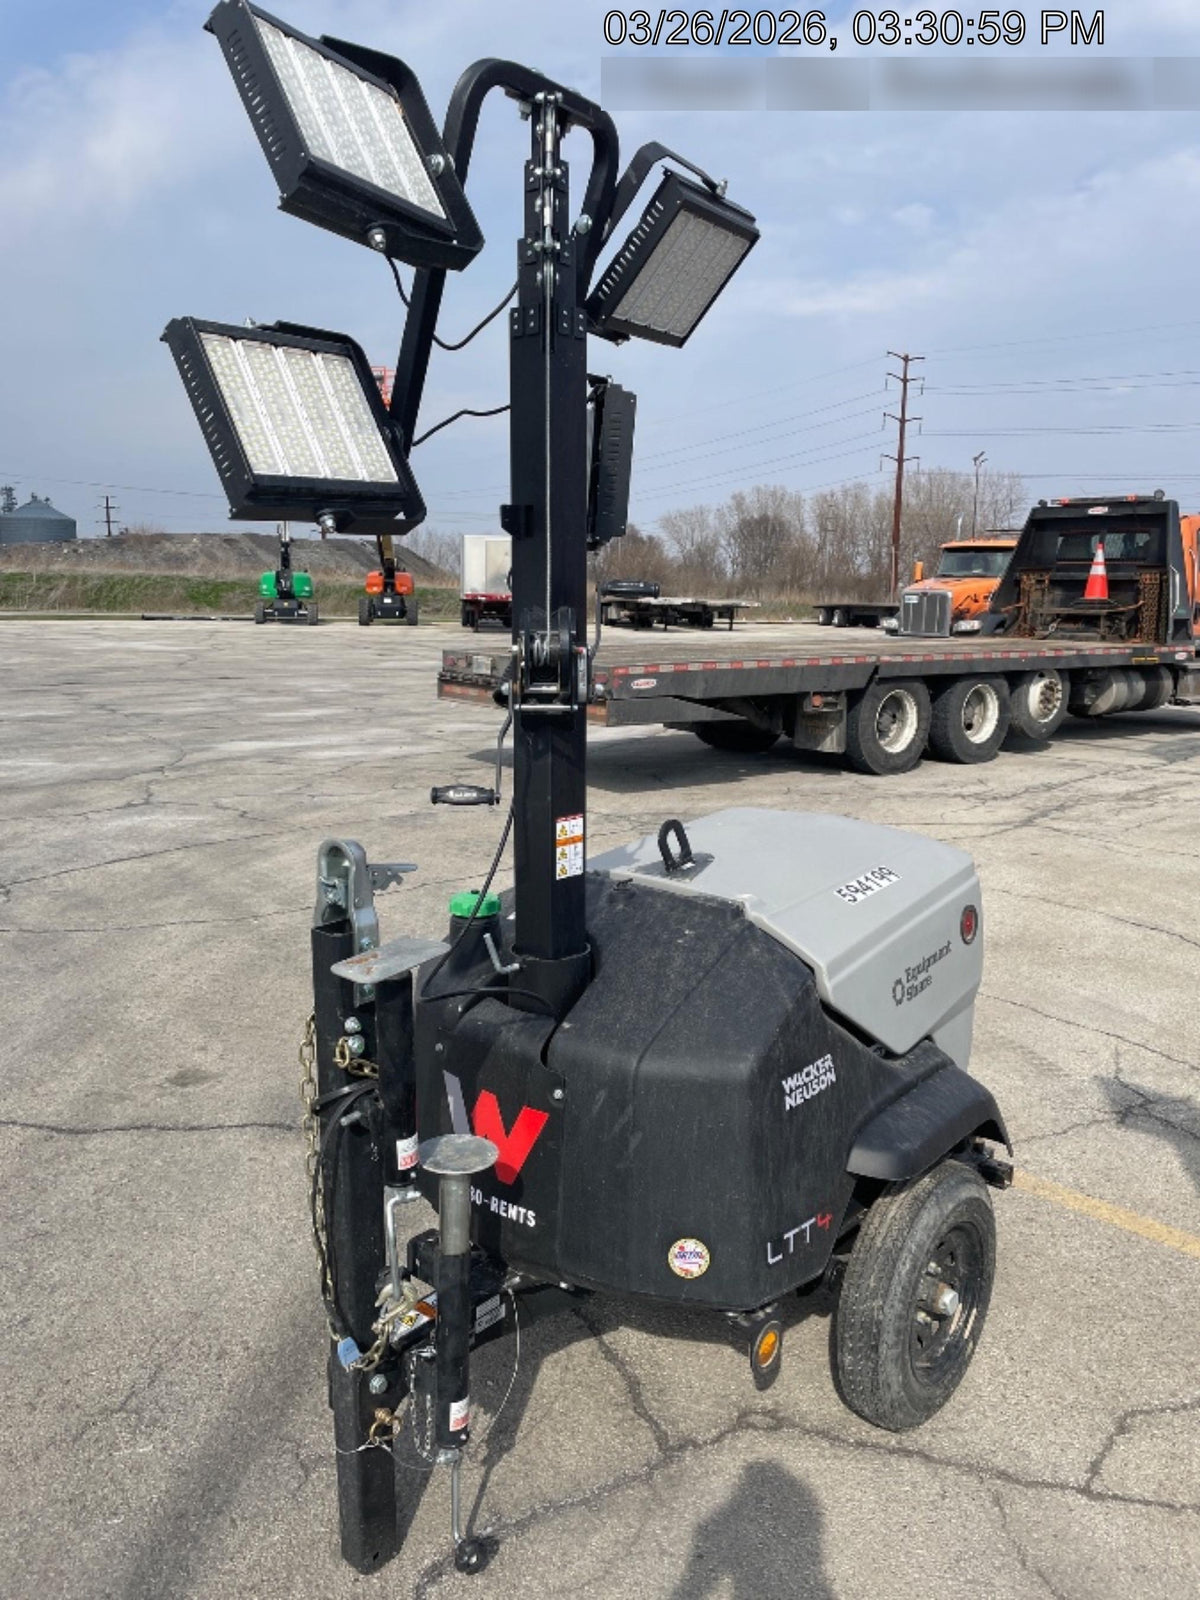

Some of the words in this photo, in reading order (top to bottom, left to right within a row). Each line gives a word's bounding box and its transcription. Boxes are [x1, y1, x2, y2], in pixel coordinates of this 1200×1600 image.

[835, 866, 901, 903] 594199
[904, 940, 952, 983] Equipment
[906, 975, 932, 1002] Share
[781, 1053, 834, 1094] WACKER
[785, 1067, 837, 1111] NEUSON
